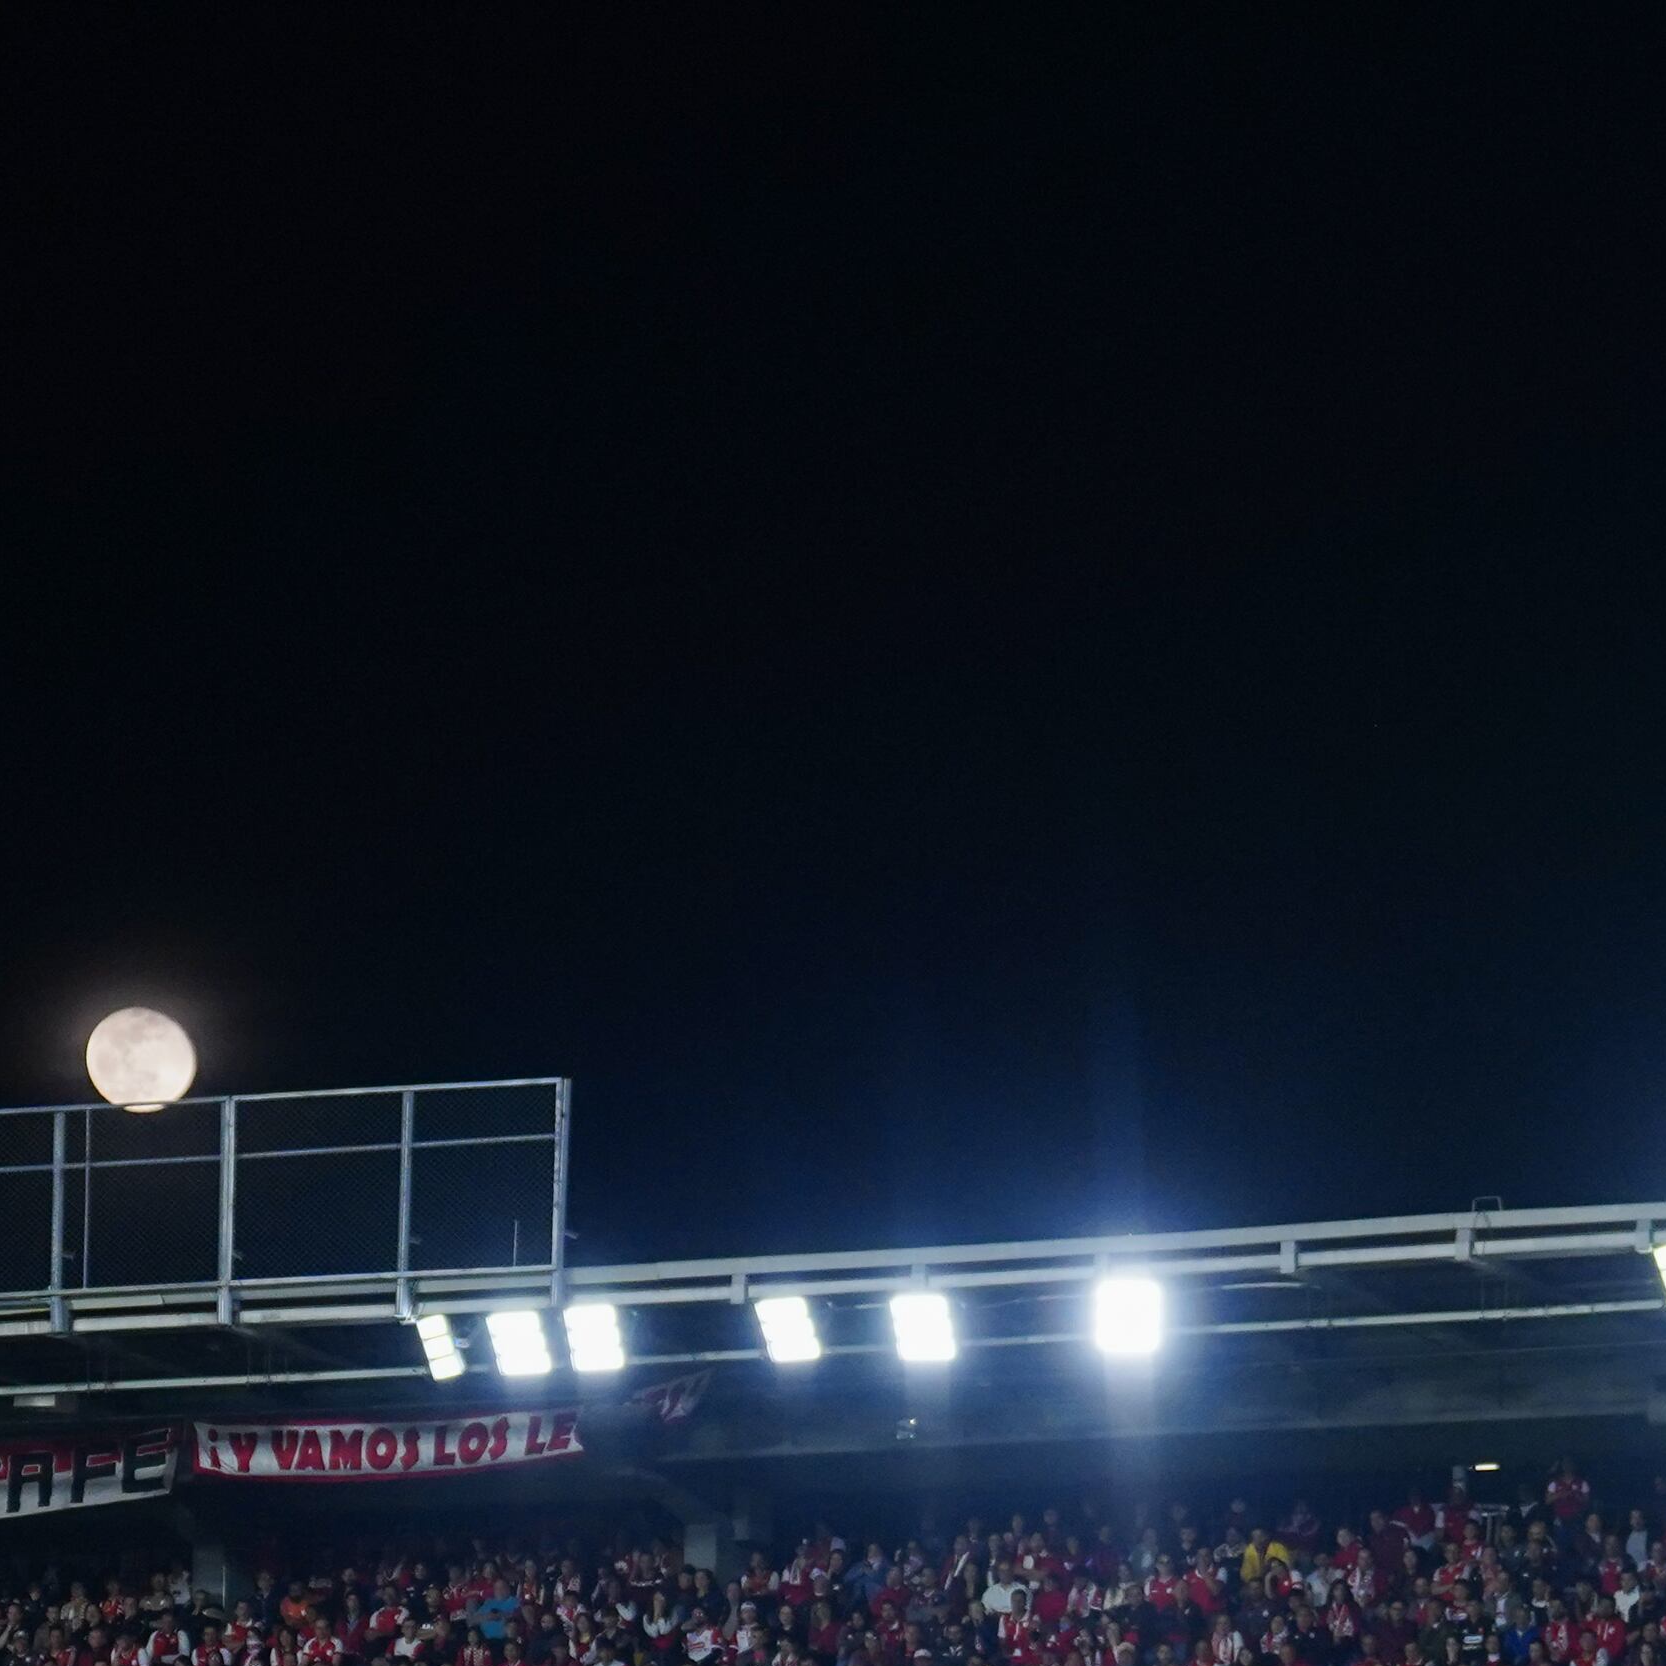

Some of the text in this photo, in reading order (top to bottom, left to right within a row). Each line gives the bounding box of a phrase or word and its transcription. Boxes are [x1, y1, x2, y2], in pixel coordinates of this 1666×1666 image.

[69, 1428, 174, 1503] FE
[270, 1426, 419, 1472] VAMOS
[433, 1417, 510, 1466] LOS
